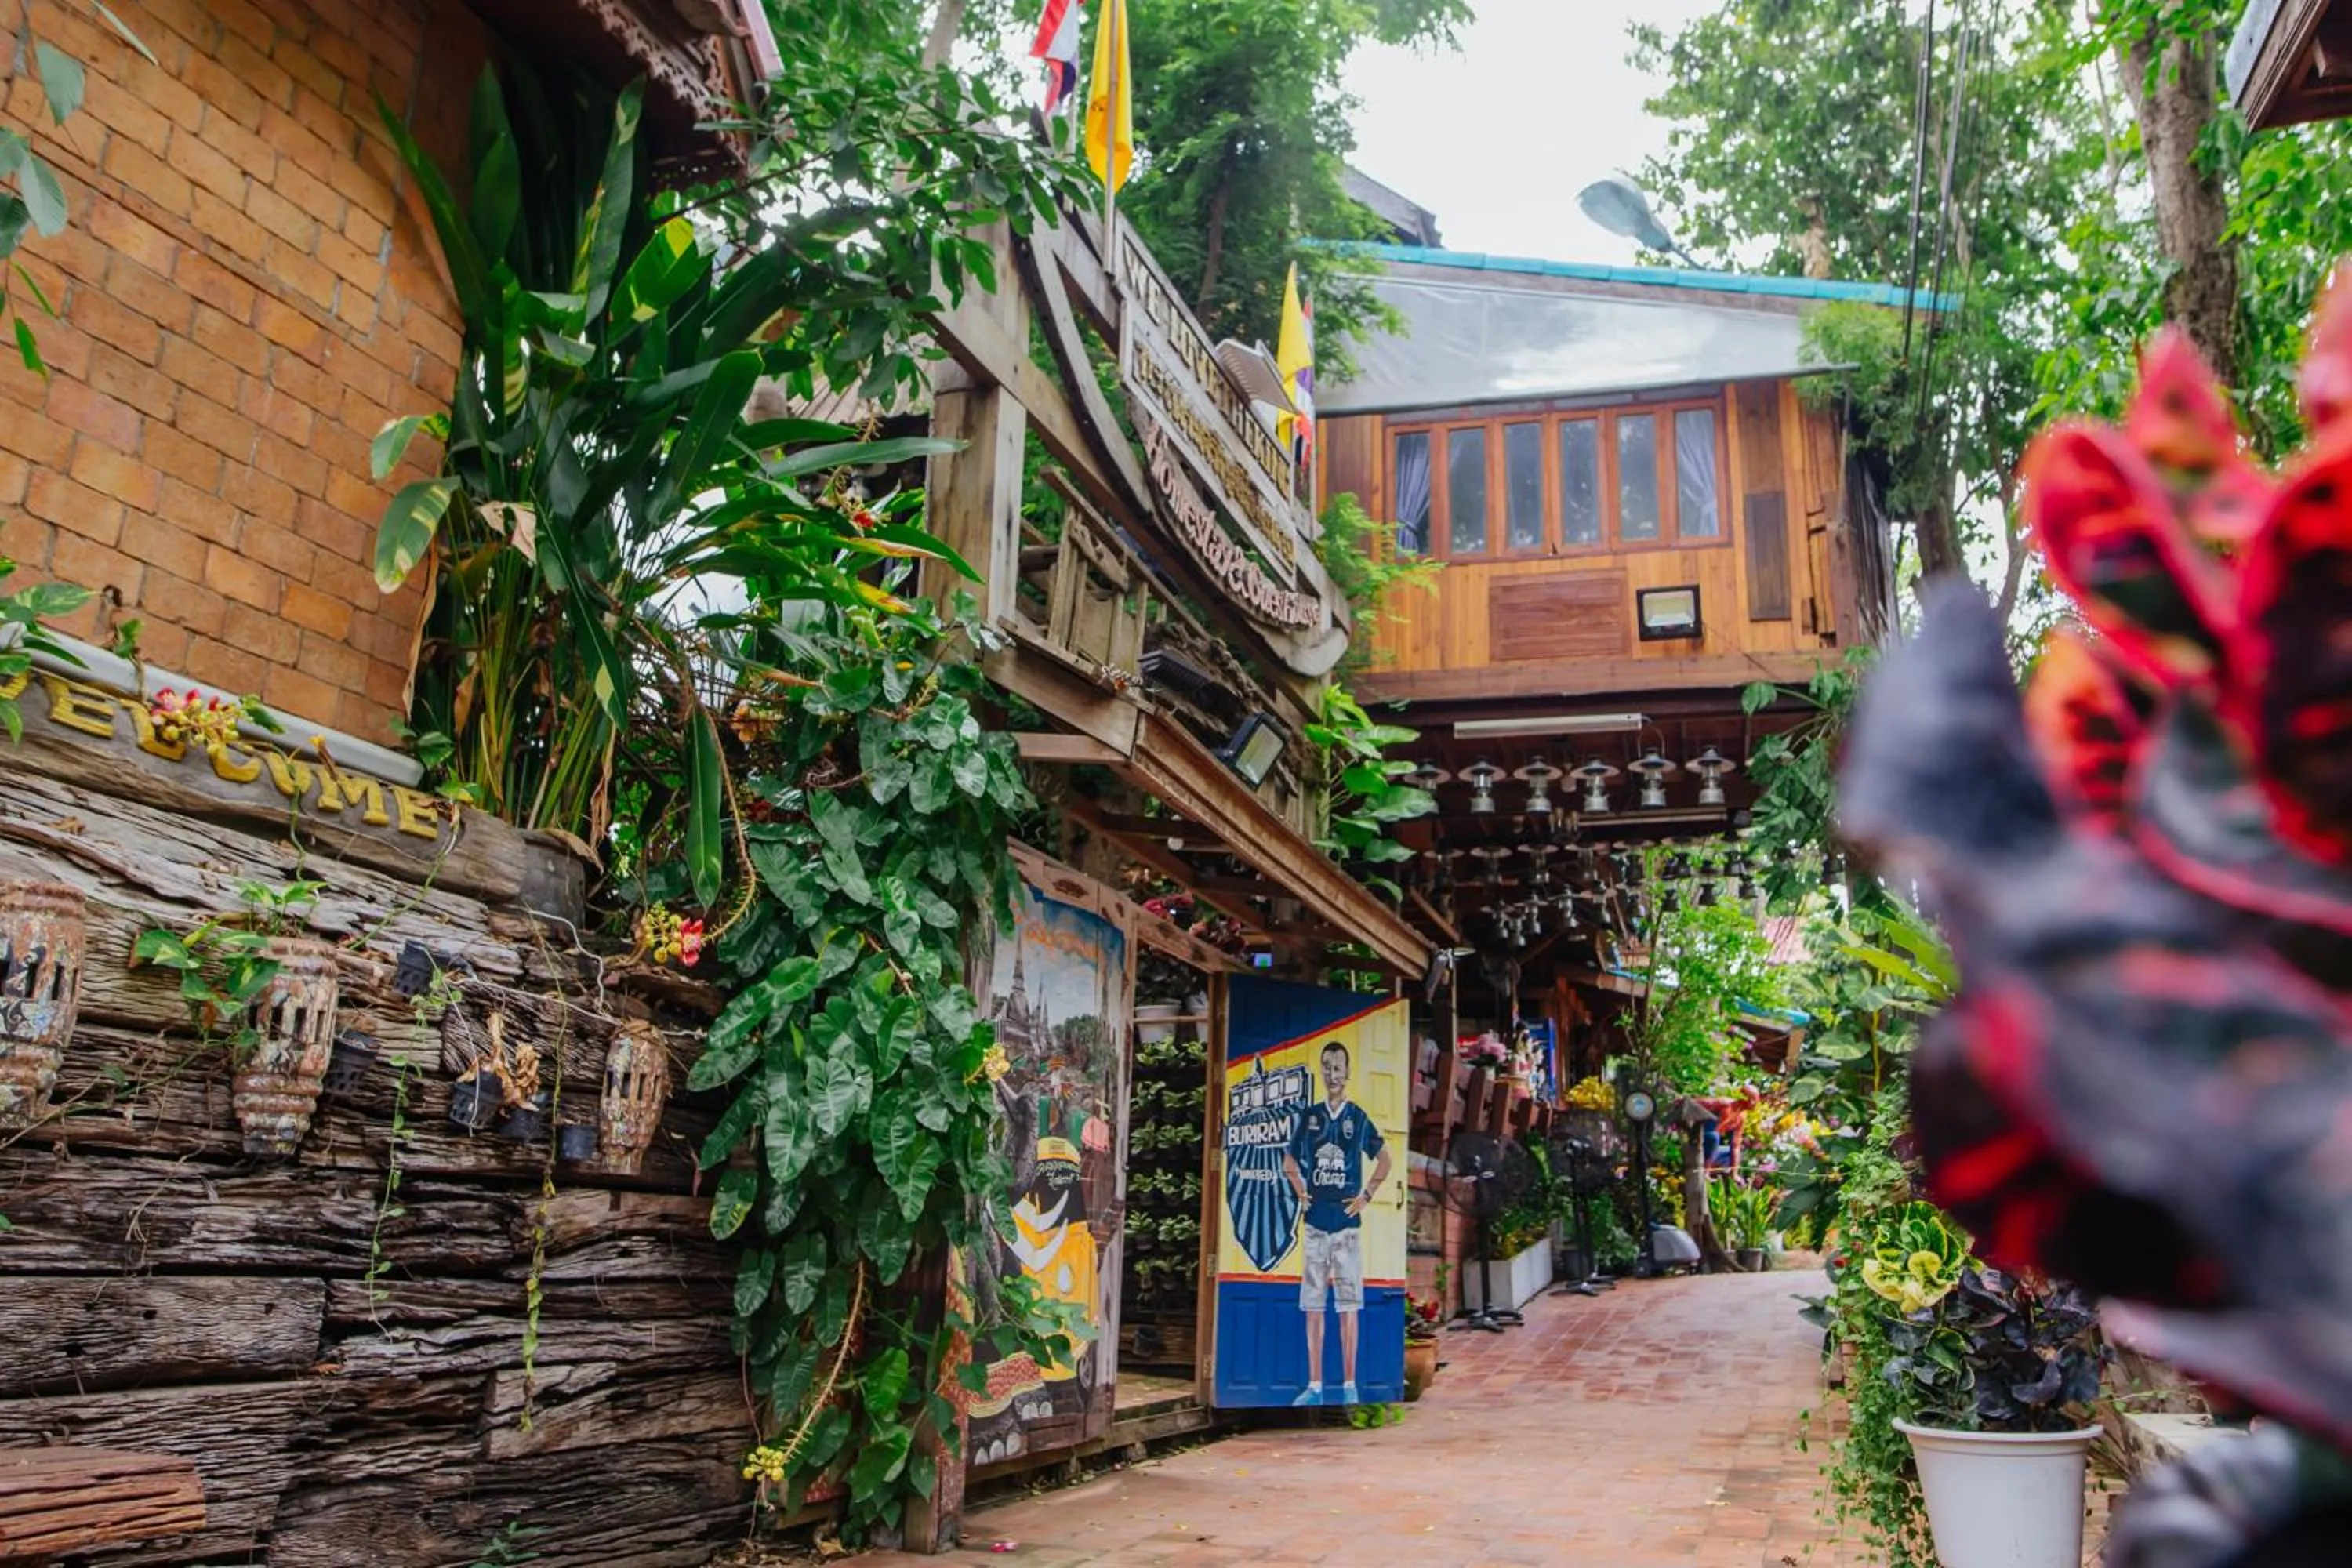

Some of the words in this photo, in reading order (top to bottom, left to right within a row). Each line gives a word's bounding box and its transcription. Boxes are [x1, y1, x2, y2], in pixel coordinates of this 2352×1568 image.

[1123, 238, 1160, 326] WE
[1168, 303, 1218, 404] LOVE
[1228, 1116, 1292, 1146] BURIRAM
